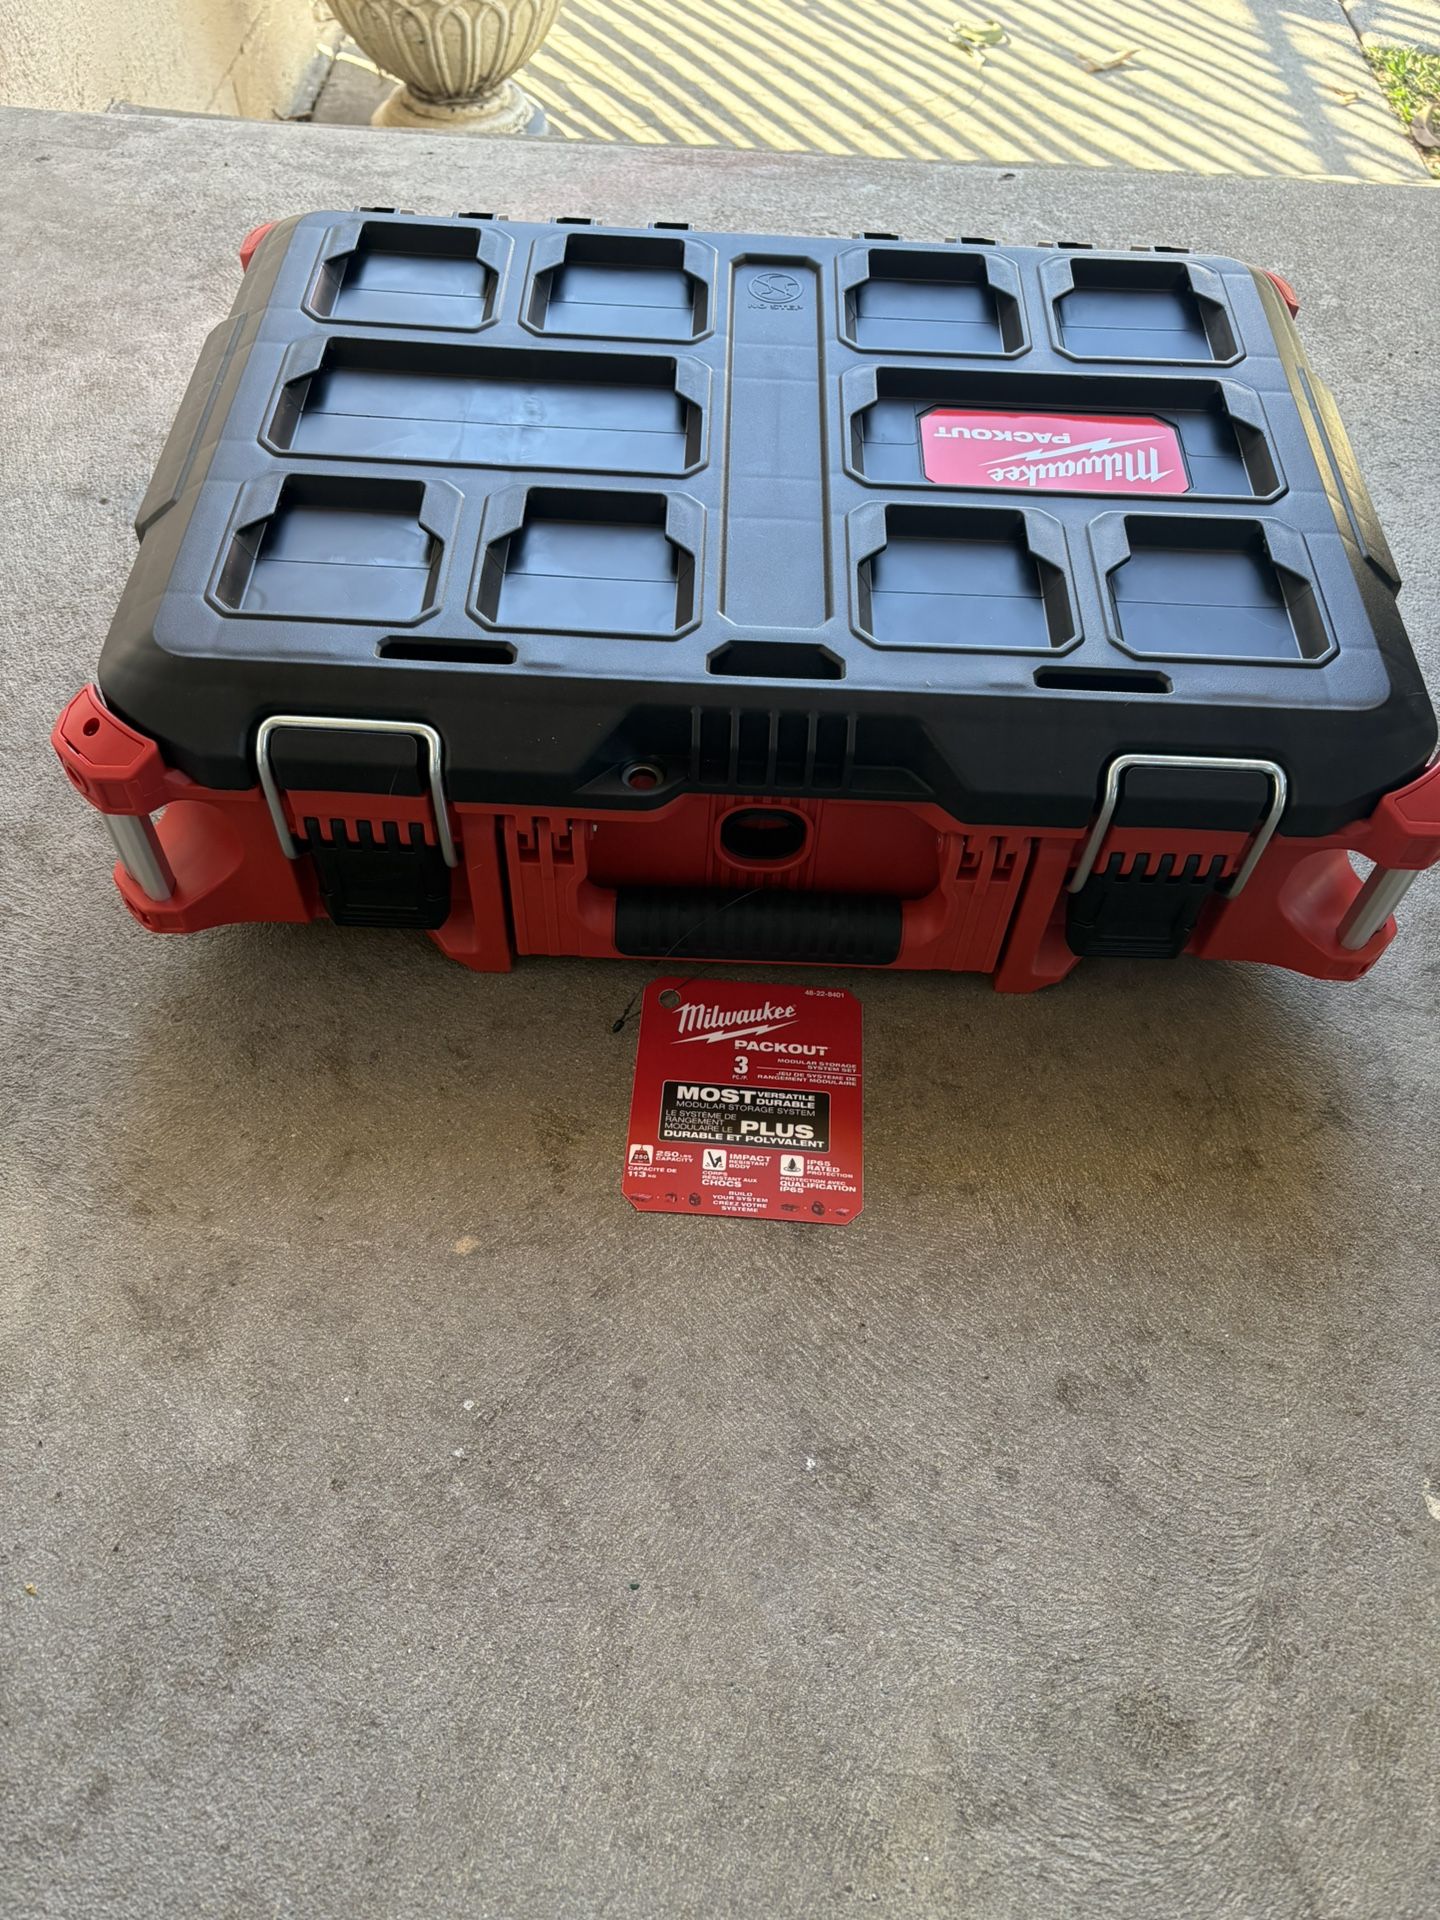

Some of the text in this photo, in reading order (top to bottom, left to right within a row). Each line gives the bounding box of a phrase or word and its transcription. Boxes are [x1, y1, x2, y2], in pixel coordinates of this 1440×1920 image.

[933, 426, 1071, 444] PACKOUT
[987, 447, 1175, 486] Milwaukee
[804, 989, 844, 998] 48-22-8401
[672, 1002, 796, 1034] Milwaukee
[734, 1040, 829, 1056] PACKOUT
[734, 1056, 748, 1074] 3
[758, 1074, 857, 1086] RANGEMENT MODULAIRE
[676, 1086, 816, 1104] MOST VERSATILE
[676, 1100, 816, 1117] MODULAR STORAGE SYSTEM
[756, 1098, 816, 1109] DURABLE
[664, 1122, 720, 1132] MODULAIRE
[665, 1116, 724, 1126] RANGEMENT
[740, 1120, 814, 1139] PLUS
[664, 1130, 723, 1140] DURABLE
[745, 1136, 824, 1148] POLYVALENT
[730, 1154, 772, 1162] IMPACT
[702, 1180, 742, 1188] CHOCS
[780, 1180, 856, 1192] QUALIFICATION
